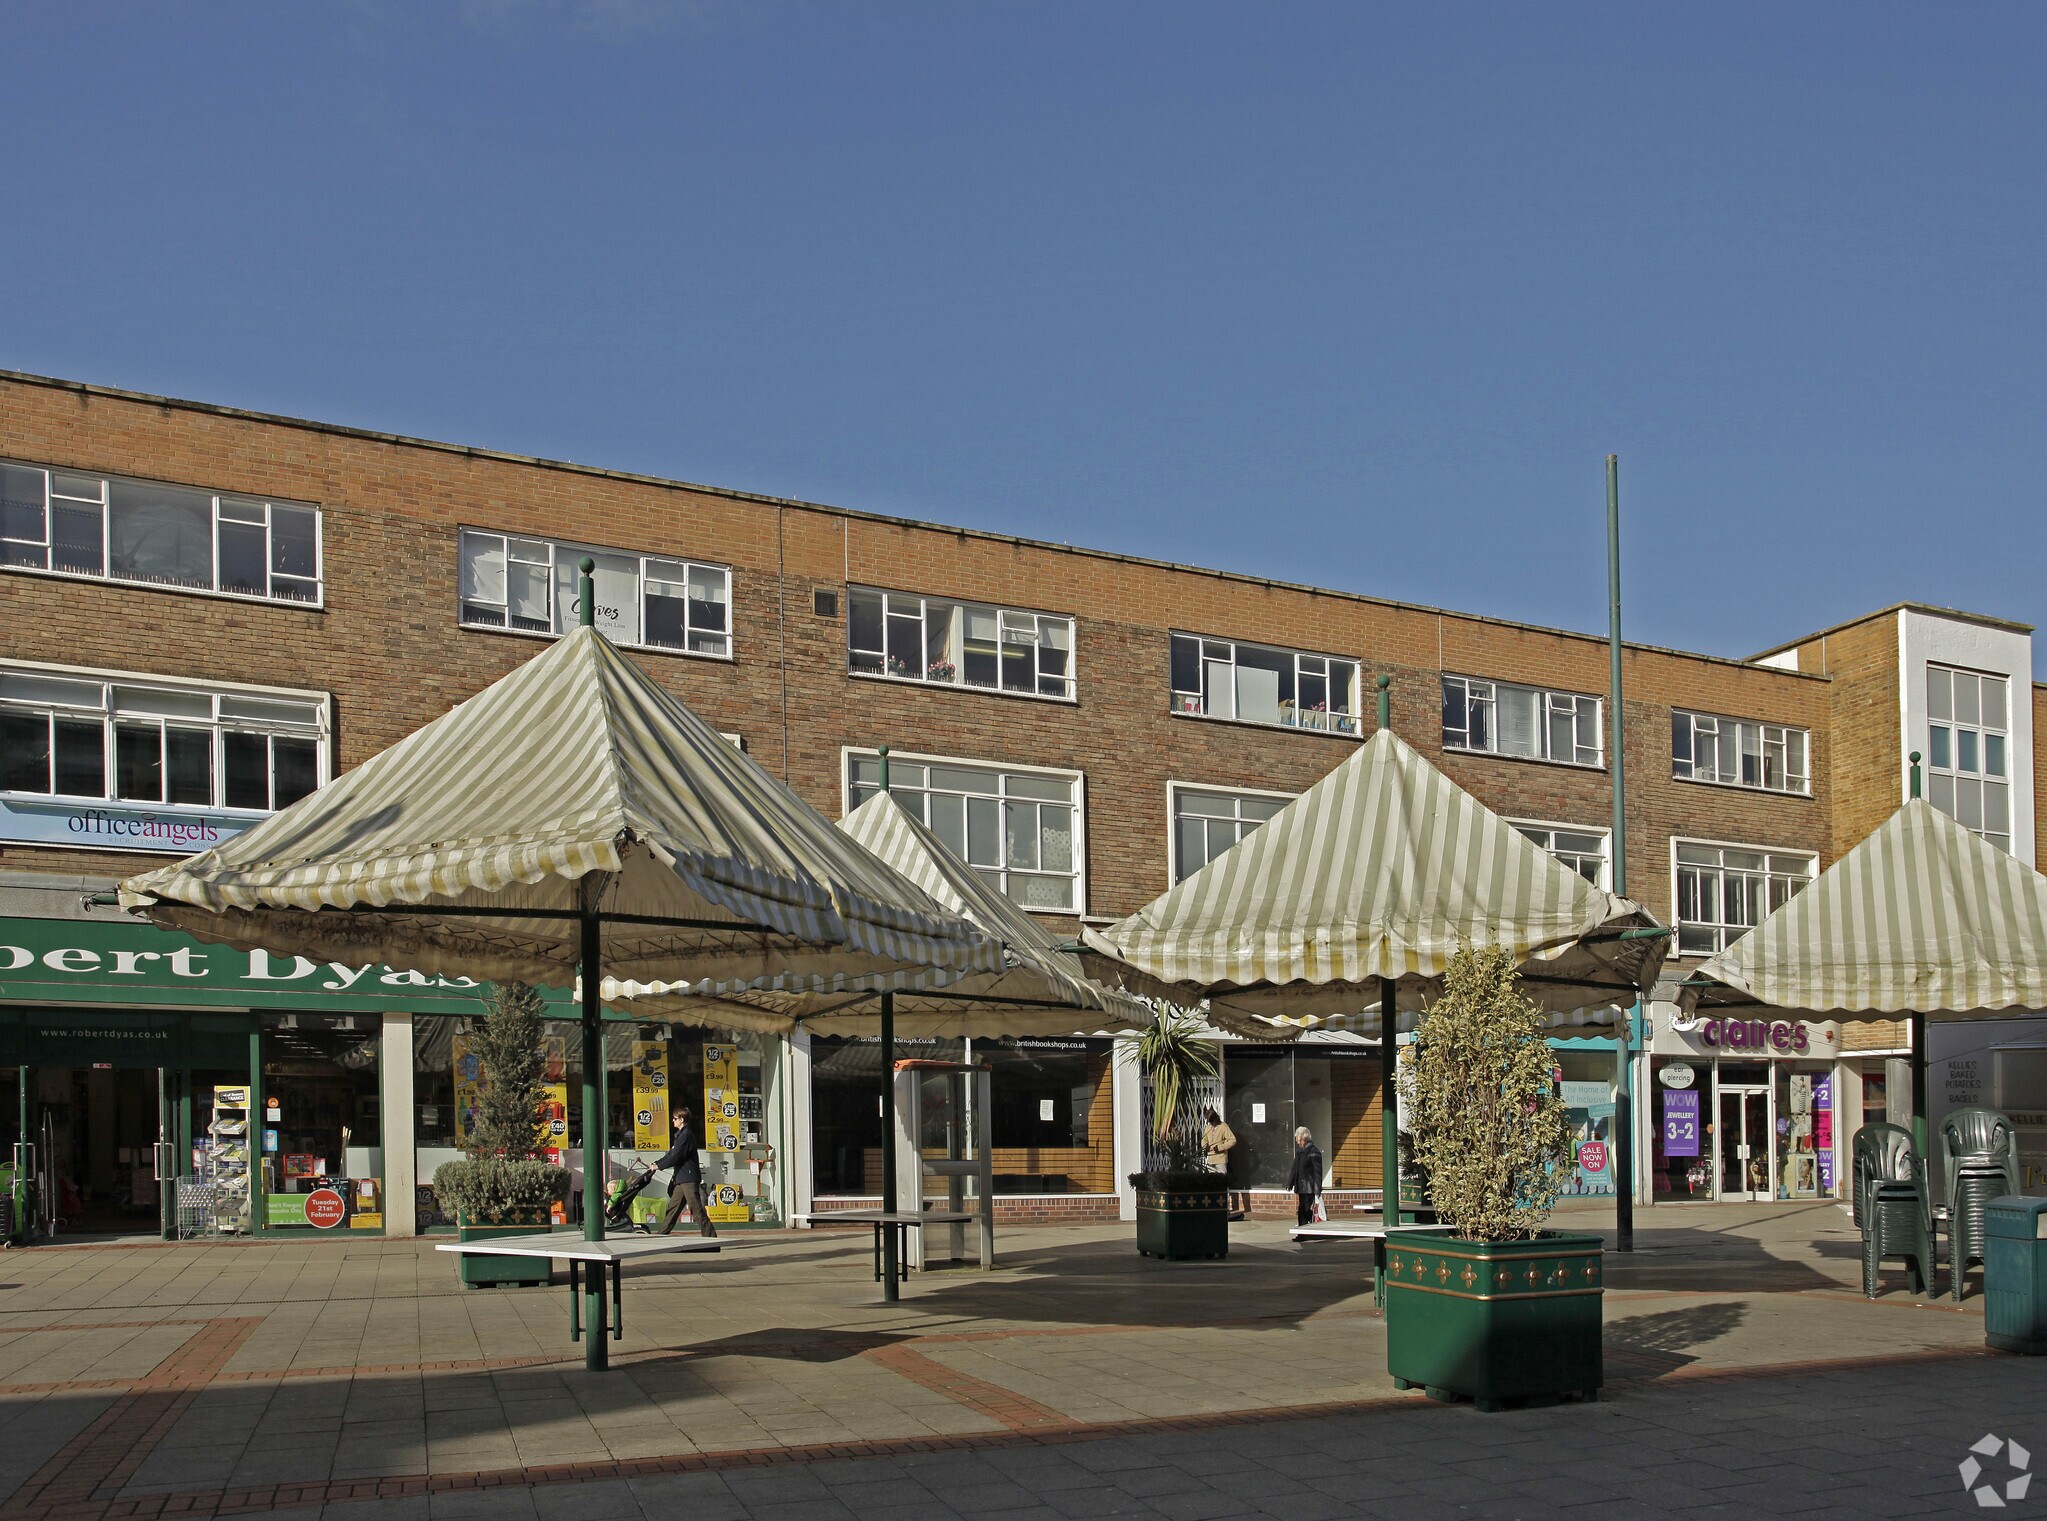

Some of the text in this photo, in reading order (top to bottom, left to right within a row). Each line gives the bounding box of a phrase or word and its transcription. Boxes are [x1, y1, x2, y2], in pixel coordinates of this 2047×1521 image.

[571, 598, 619, 620] Cves
[68, 809, 218, 846] officeangels
[108, 836, 169, 846] RECRUITMENT
[40, 1029, 168, 1039] www.robertdyas.co.uk
[1703, 1018, 1807, 1049] claire's
[998, 1039, 1087, 1050] www.britishbookshops.co.uk
[1948, 1061, 1977, 1070] KELLIES
[1667, 1074, 1691, 1082] piercing
[1950, 1070, 1976, 1079] BAKED
[1946, 1080, 1981, 1089] POTATOES
[1578, 1086, 1599, 1094] Home
[1821, 1090, 1828, 1100] 2
[1576, 1095, 1606, 1103] Inclusive
[1664, 1094, 1697, 1106] WOW
[1949, 1095, 1978, 1103] BAGELS
[1667, 1122, 1677, 1139] 3
[1684, 1122, 1694, 1139] 2
[1822, 1169, 1830, 1179] 2
[417, 1190, 431, 1199] 1/2
[721, 1190, 734, 1198] 1/2
